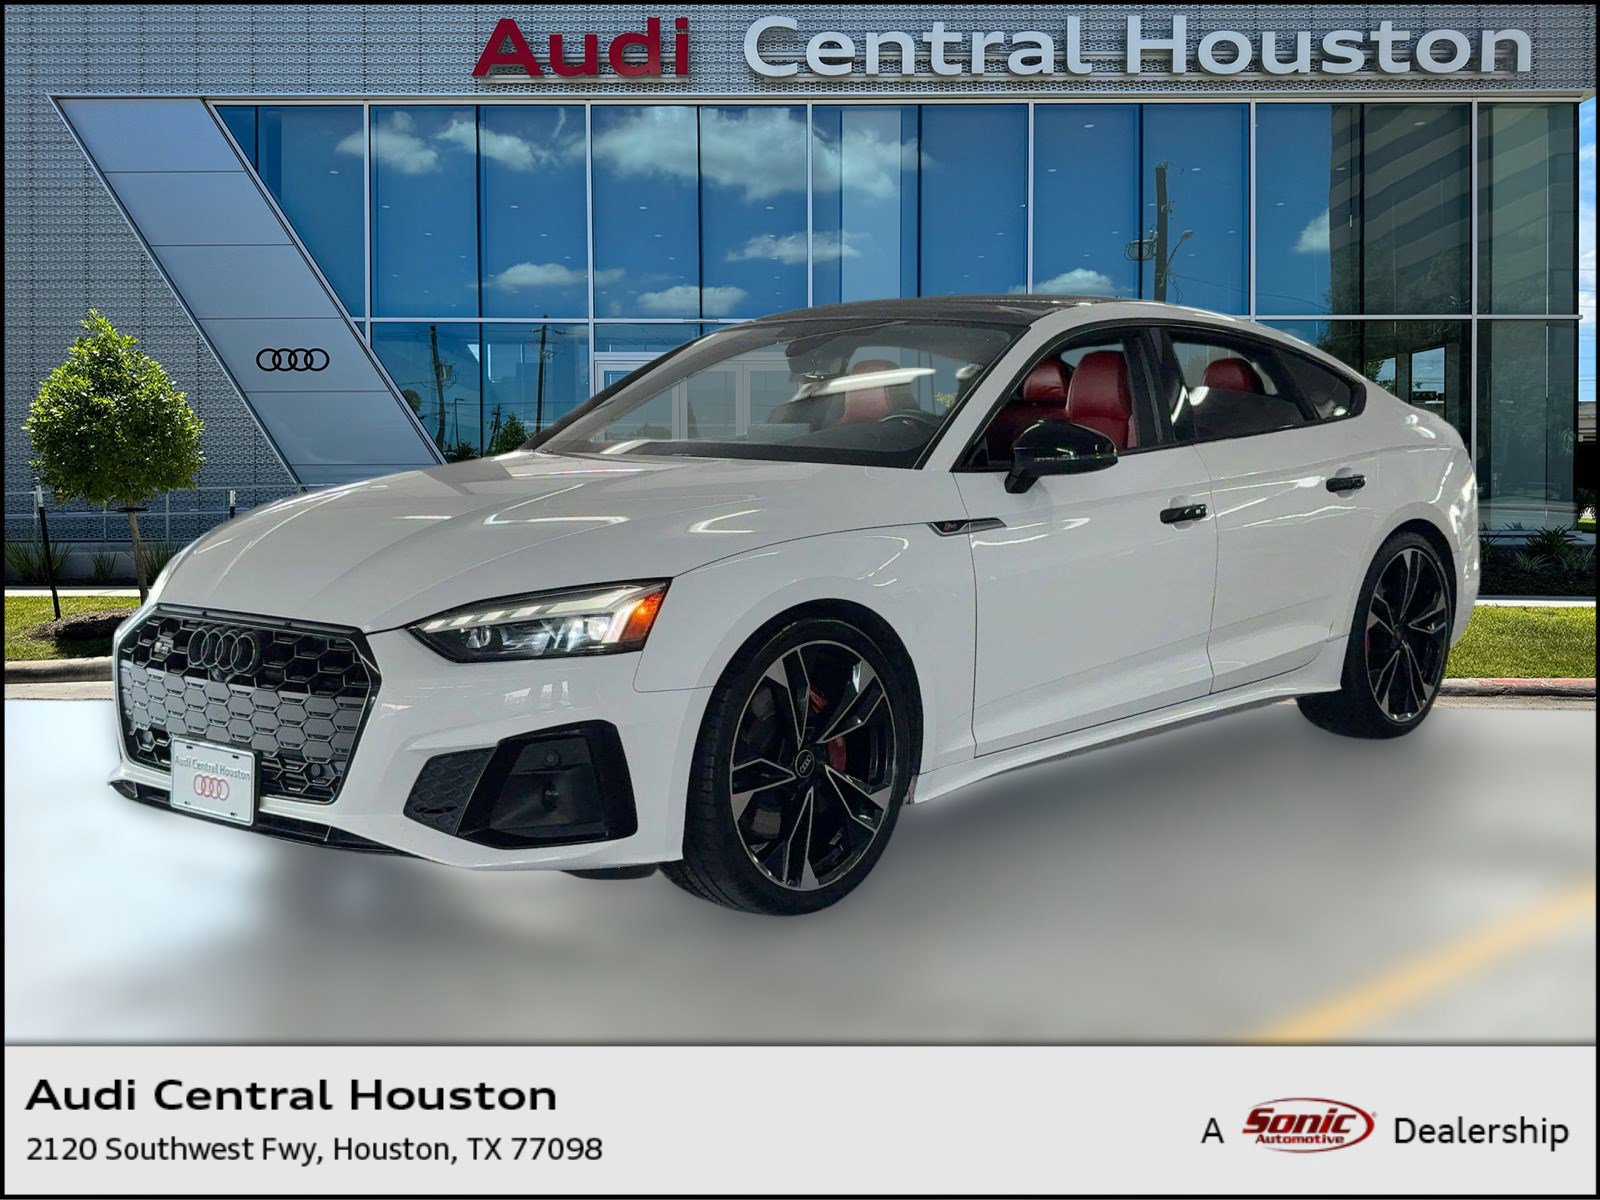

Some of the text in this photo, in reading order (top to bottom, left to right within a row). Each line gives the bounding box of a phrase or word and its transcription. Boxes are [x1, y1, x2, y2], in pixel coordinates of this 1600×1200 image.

[471, 15, 1532, 78] Audi Central Houston
[174, 755, 251, 781] Audi Central Houston
